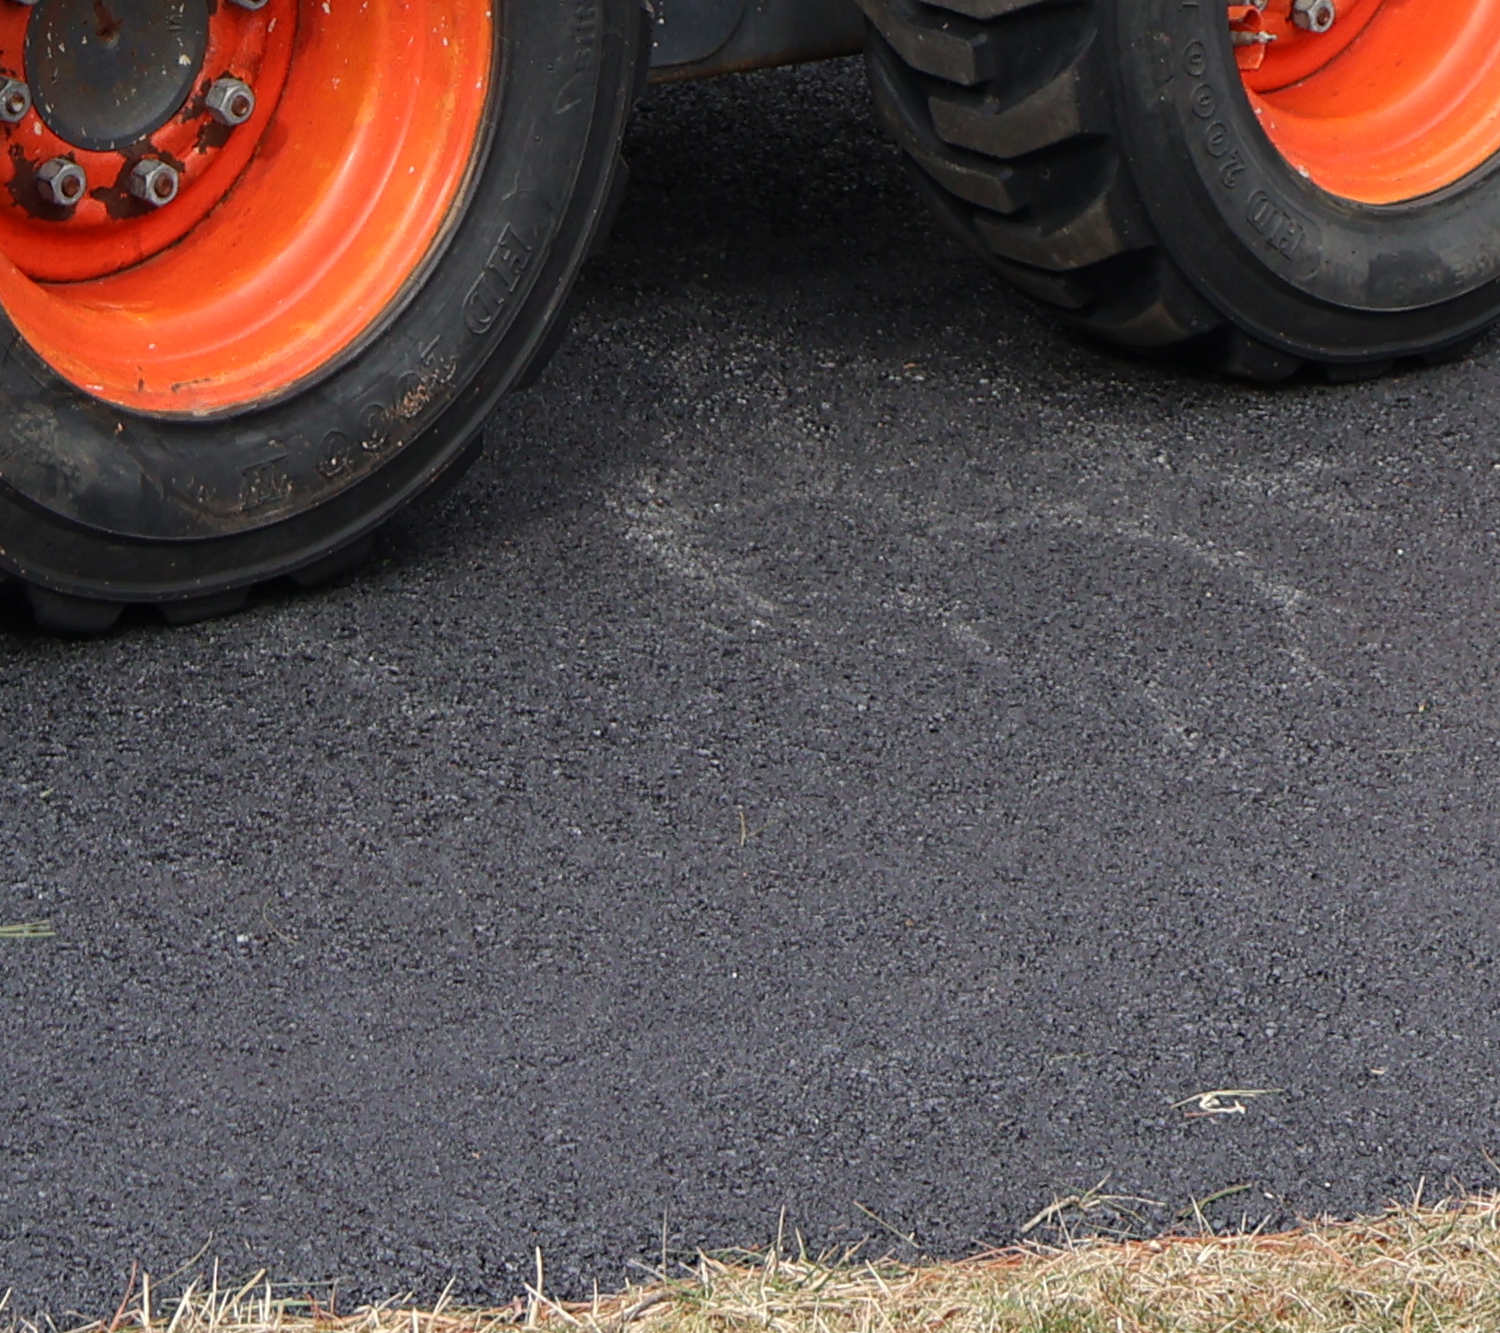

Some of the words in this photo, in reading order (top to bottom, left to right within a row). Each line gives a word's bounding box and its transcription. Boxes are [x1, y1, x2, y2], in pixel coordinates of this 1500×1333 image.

[1183, 40, 1245, 190] 2000
[463, 221, 534, 335] HD
[1243, 189, 1306, 260] HD
